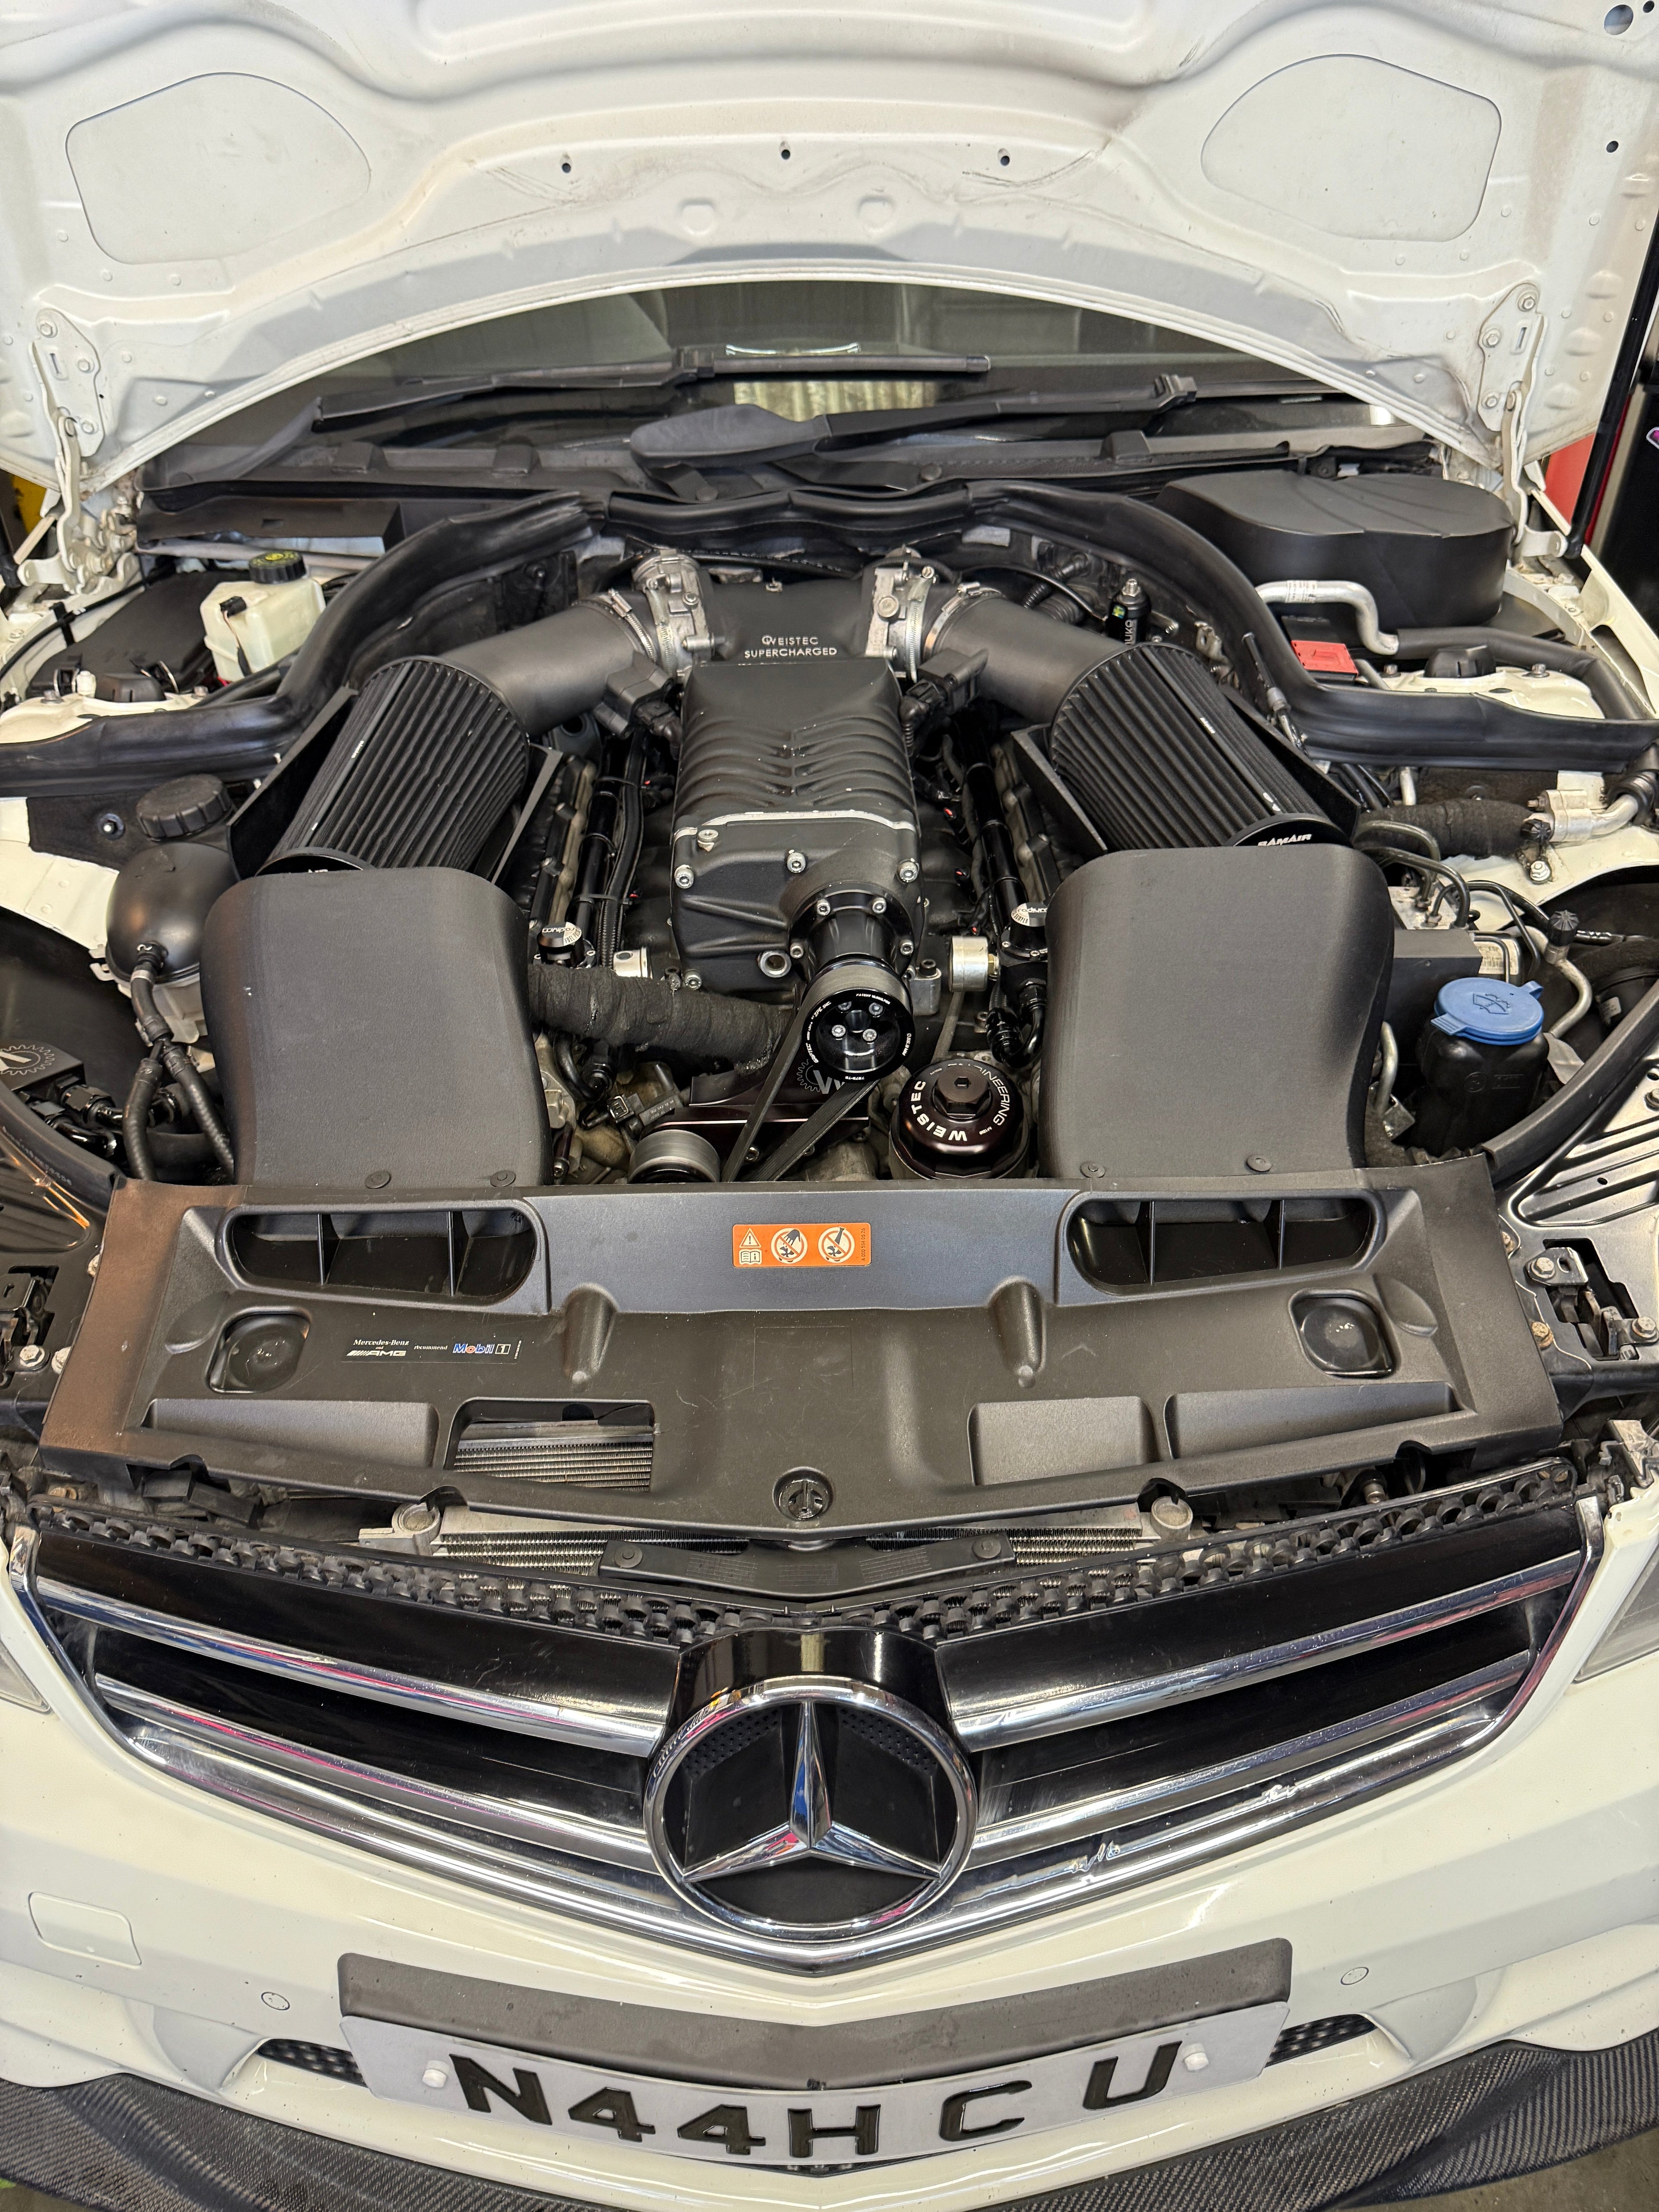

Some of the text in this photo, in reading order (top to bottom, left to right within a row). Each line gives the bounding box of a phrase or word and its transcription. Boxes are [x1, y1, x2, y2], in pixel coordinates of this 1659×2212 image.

[744, 648, 837, 658] SUPERCHARGED
[1258, 834, 1313, 846] RAMAIR
[911, 1081, 967, 1141] WEISTEC
[452, 1343, 496, 1354] Mobil
